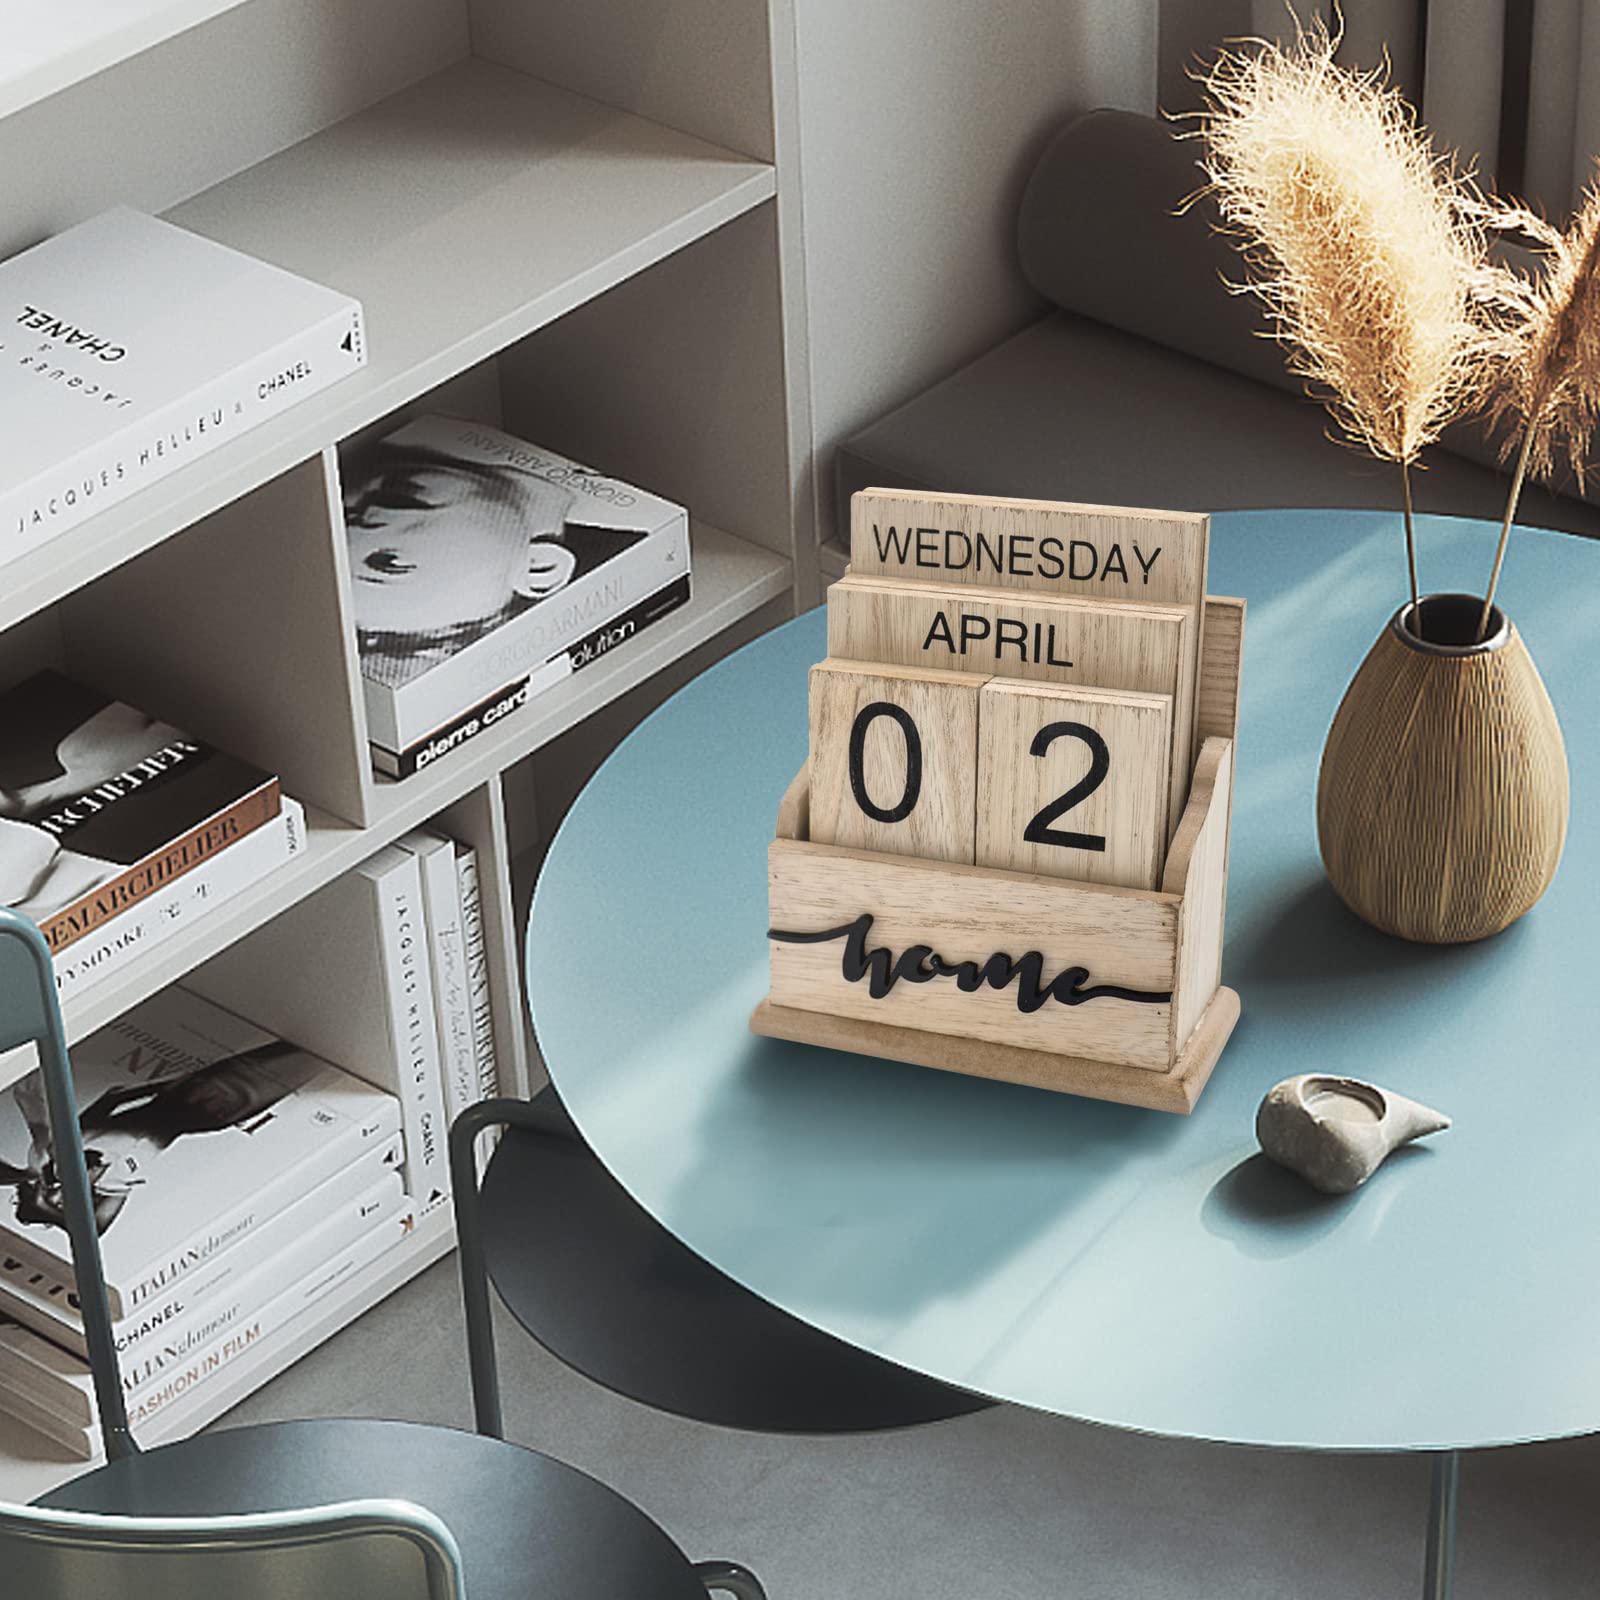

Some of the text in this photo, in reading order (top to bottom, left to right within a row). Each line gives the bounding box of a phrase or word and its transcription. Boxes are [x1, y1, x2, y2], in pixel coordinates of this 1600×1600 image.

[16, 305, 127, 362] CHANEL
[19, 357, 133, 408] JACQUES
[19, 463, 126, 533] JACQUES
[138, 409, 223, 467] HELLEU
[257, 360, 312, 400] CHANEL
[457, 430, 637, 508] GIORGIO ARMANI
[872, 523, 1162, 585] WEDNESDAY
[922, 611, 1074, 669] APRIL
[415, 718, 479, 770] pierre
[848, 702, 1111, 853] 0 2
[461, 864, 487, 996] CAROLINA
[767, 912, 1172, 1014] home
[420, 1112, 435, 1166] CHANEL
[130, 1243, 200, 1306] ITALIAN
[115, 1300, 185, 1351] CHANEL
[128, 1321, 262, 1425] FASHION IN FILM
